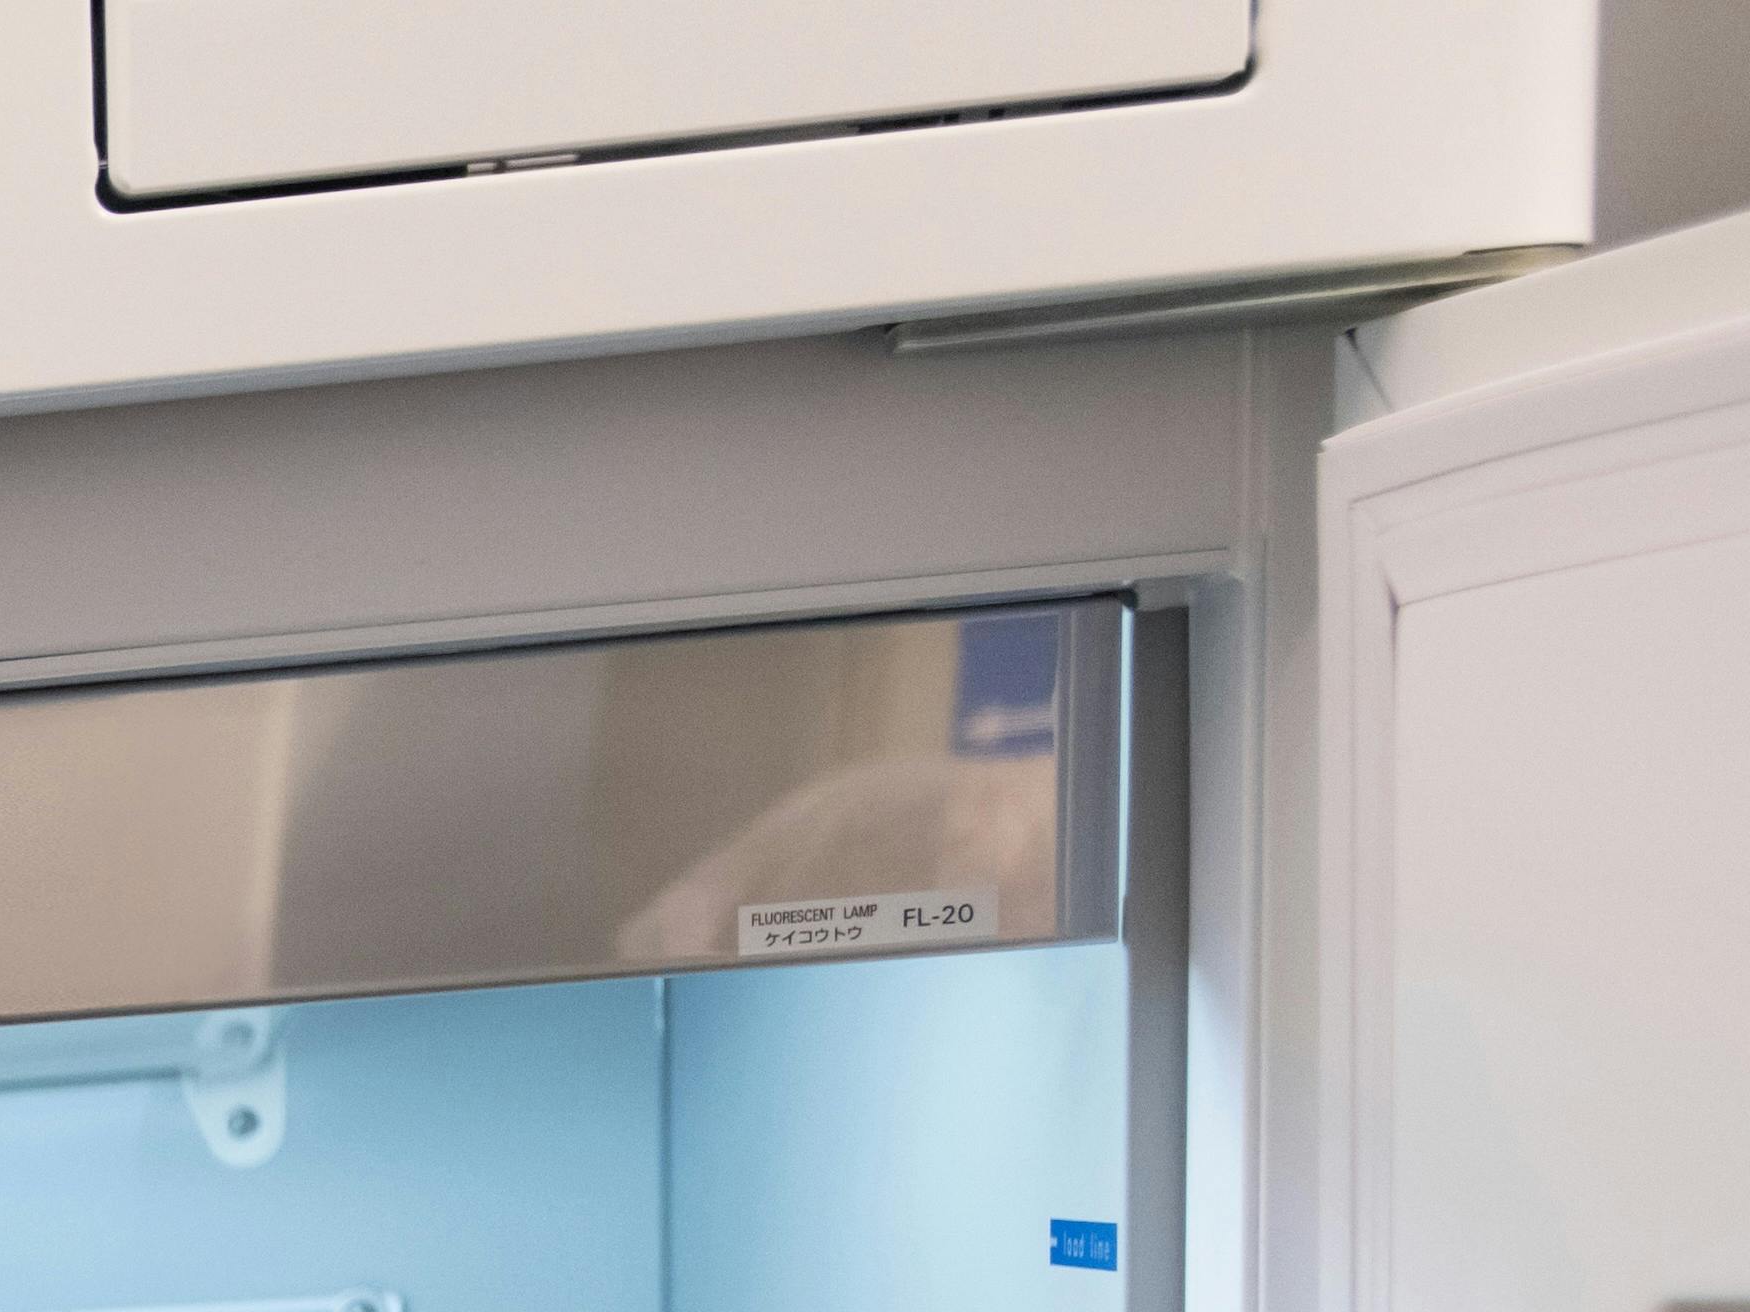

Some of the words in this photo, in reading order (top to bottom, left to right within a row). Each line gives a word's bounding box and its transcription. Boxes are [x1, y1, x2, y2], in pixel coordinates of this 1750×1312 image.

[751, 906, 836, 927] FLUORESCENT
[843, 903, 878, 920] LAMP
[902, 902, 975, 928] FL-20
[764, 924, 863, 947] ケイコウトウ
